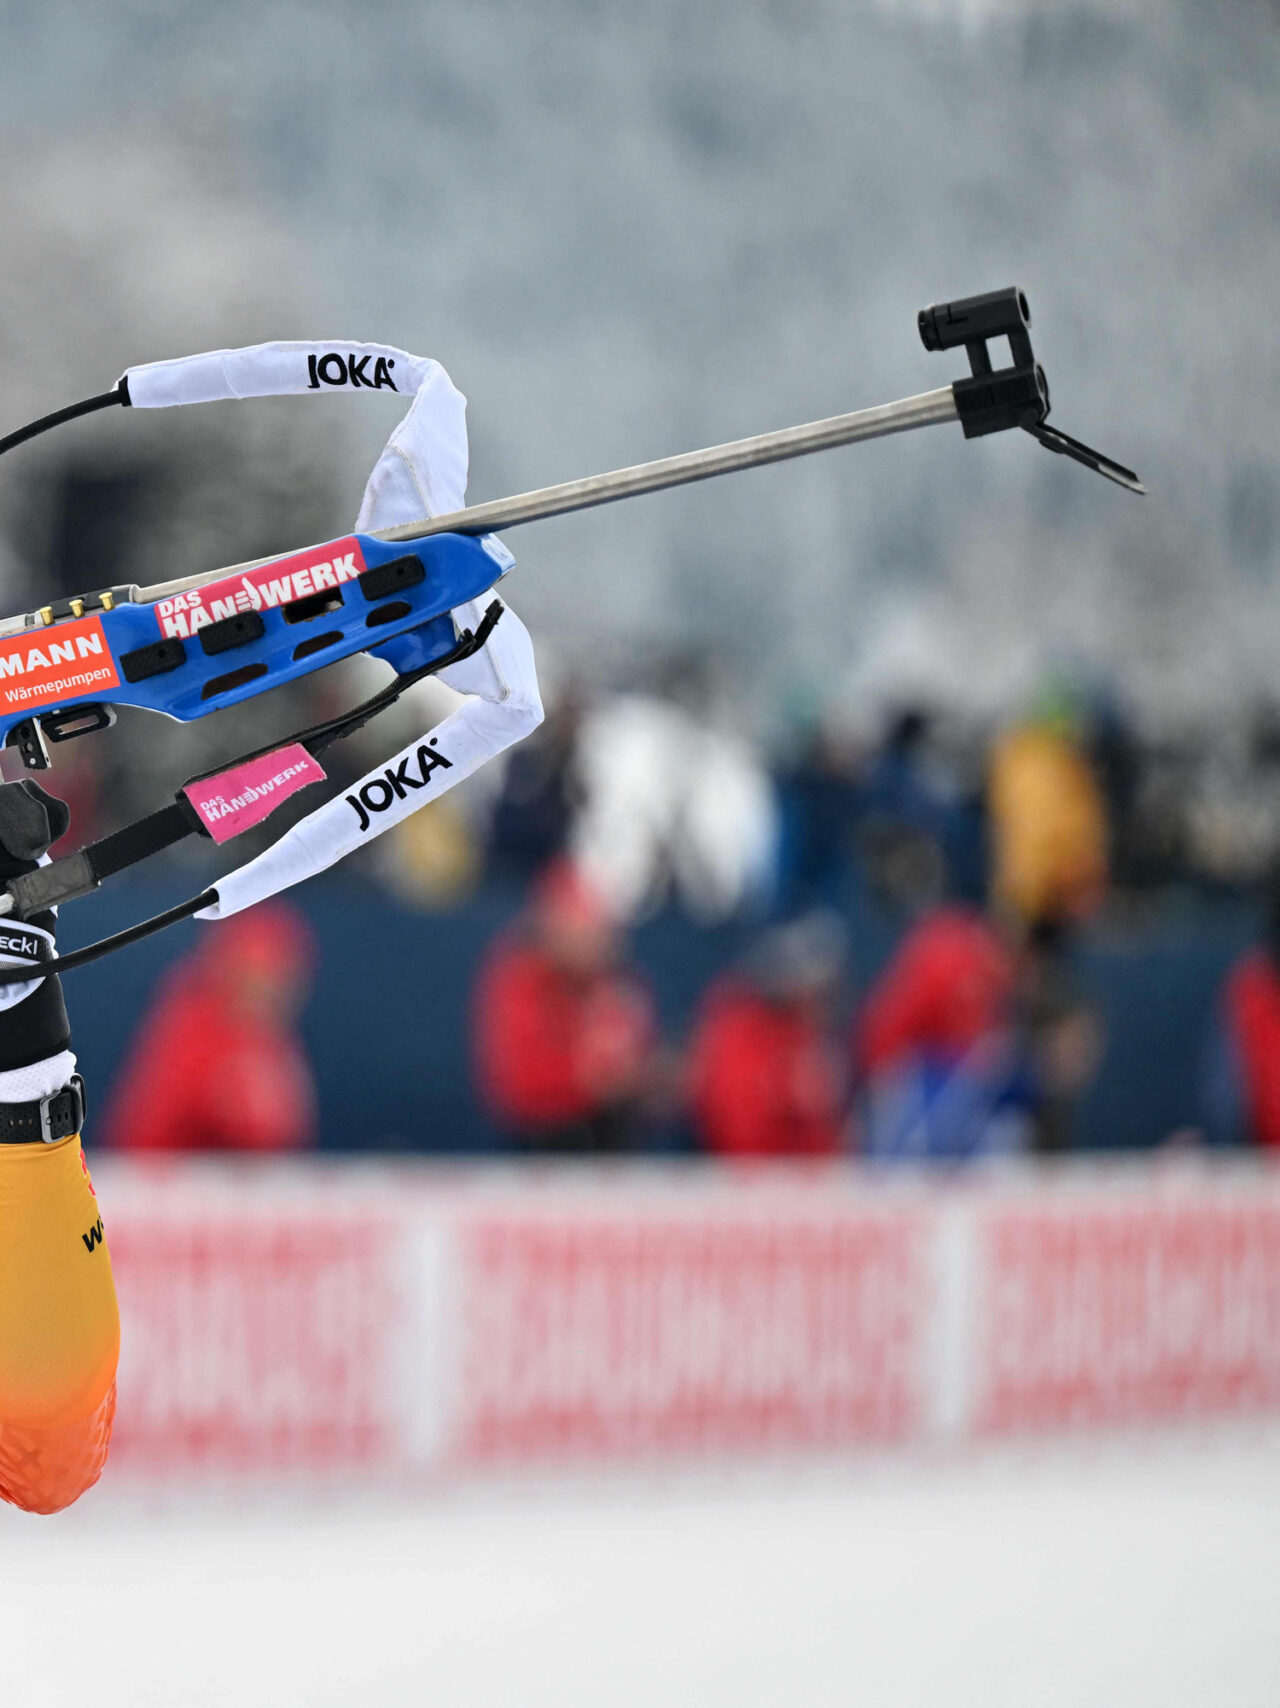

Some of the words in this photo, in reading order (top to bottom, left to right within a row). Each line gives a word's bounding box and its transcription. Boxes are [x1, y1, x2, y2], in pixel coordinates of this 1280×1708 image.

[307, 352, 400, 393] JOKA
[157, 591, 202, 618] DAS
[4, 667, 111, 703] Wärmepumpen
[345, 737, 454, 832] JOKA
[200, 795, 226, 811] DAS
